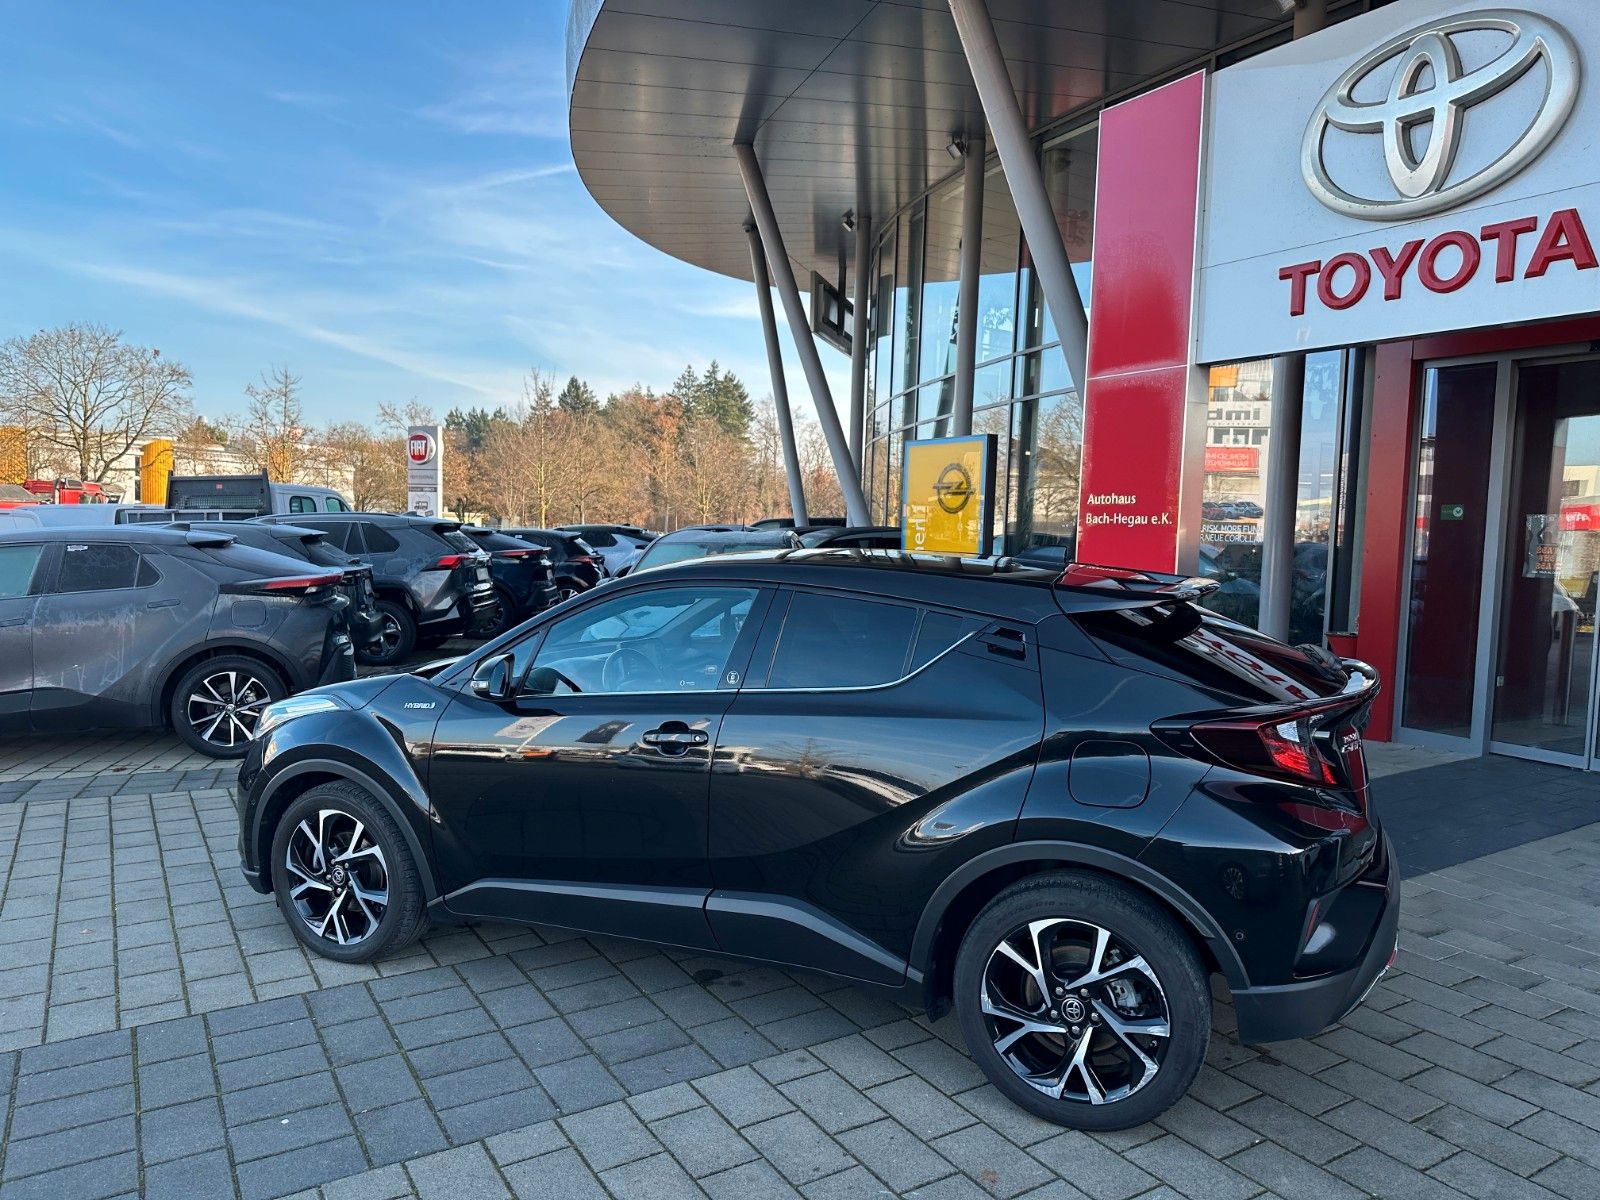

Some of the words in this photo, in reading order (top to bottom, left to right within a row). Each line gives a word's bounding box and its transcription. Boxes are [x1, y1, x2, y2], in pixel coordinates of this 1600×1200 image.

[1279, 208, 1599, 316] TOYOTA
[411, 440, 427, 456] FIAT
[1087, 493, 1136, 504] Autohaus
[1086, 513, 1148, 527] Bach-Hegau
[1151, 513, 1172, 525] e.K.
